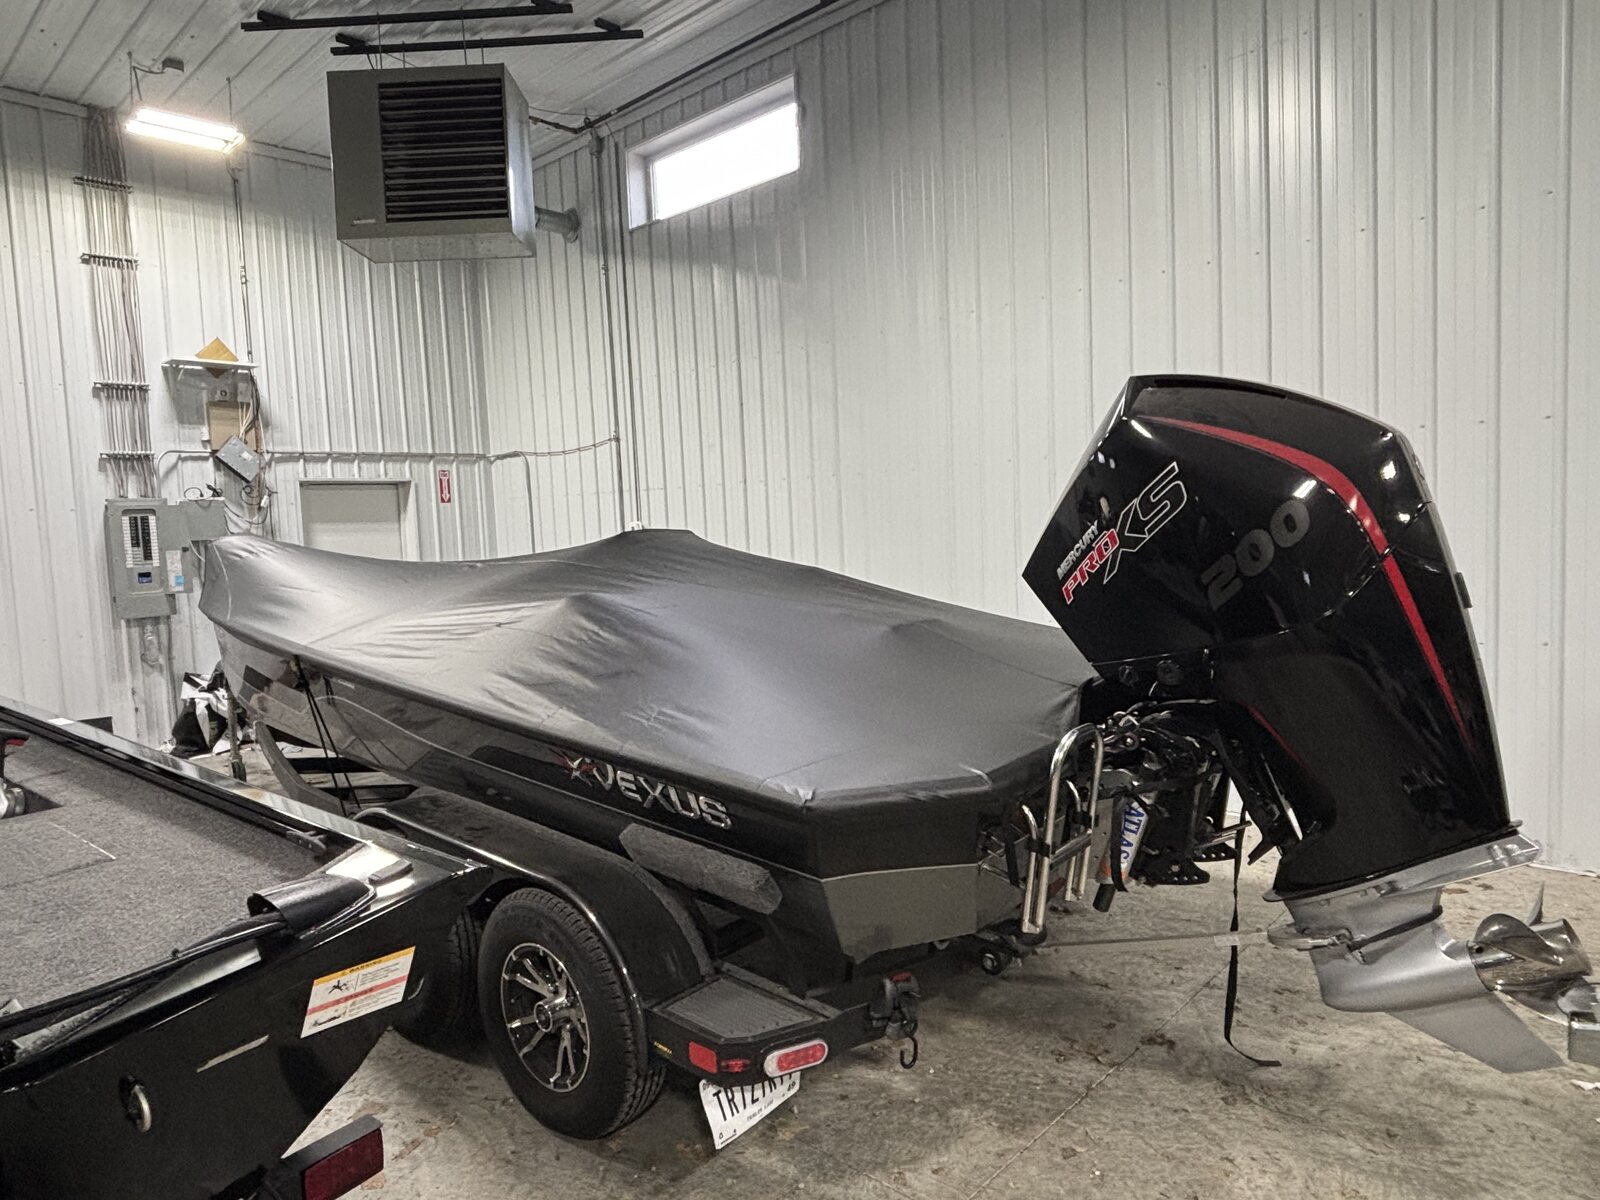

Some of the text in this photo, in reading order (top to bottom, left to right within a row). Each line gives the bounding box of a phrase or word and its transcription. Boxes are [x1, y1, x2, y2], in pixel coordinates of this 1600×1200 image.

[1056, 519, 1099, 580] MERCURY
[1201, 498, 1311, 612] 200
[592, 761, 733, 830] VEXUS
